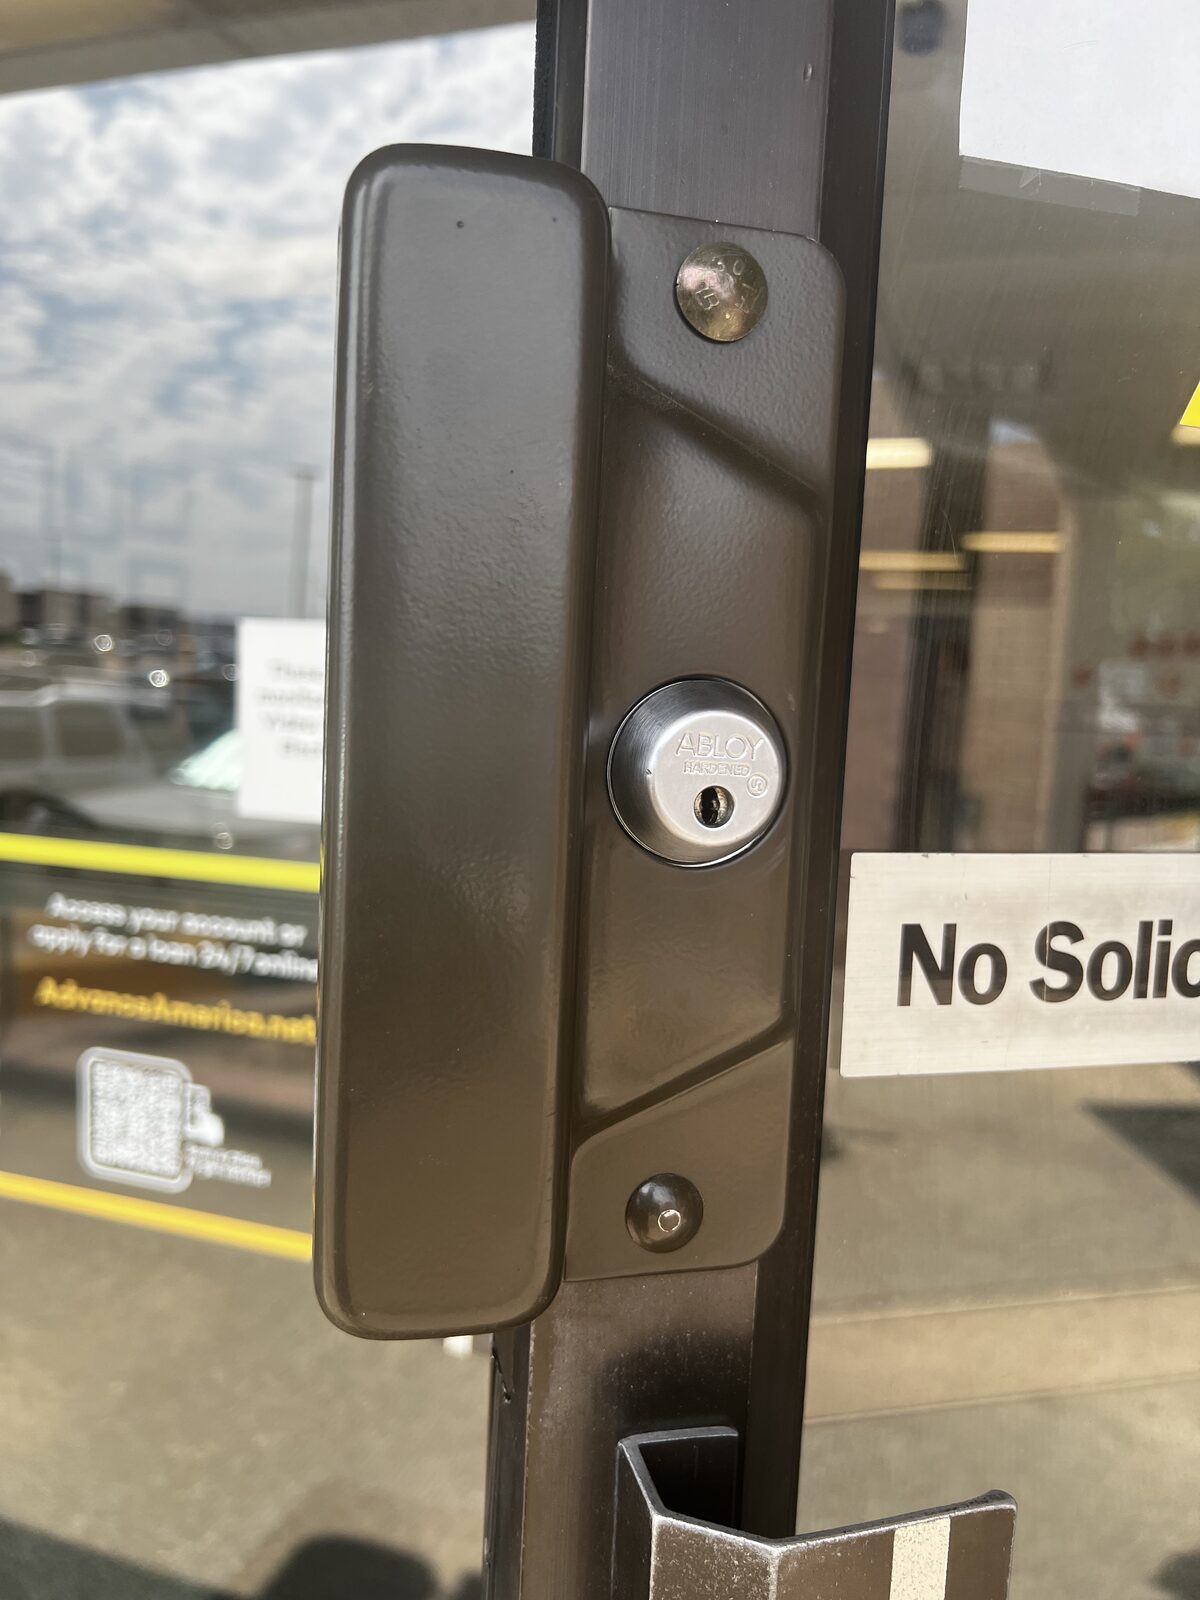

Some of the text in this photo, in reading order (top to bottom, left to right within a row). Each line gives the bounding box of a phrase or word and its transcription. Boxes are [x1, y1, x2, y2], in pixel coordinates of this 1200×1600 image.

[675, 732, 764, 760] ABLOY
[683, 761, 751, 778] HARDENED
[44, 892, 307, 947] Access your account or
[27, 924, 91, 958] apply
[91, 926, 127, 957] for
[127, 936, 147, 960] a
[147, 932, 196, 965] loan
[897, 919, 1200, 1006] No Solic
